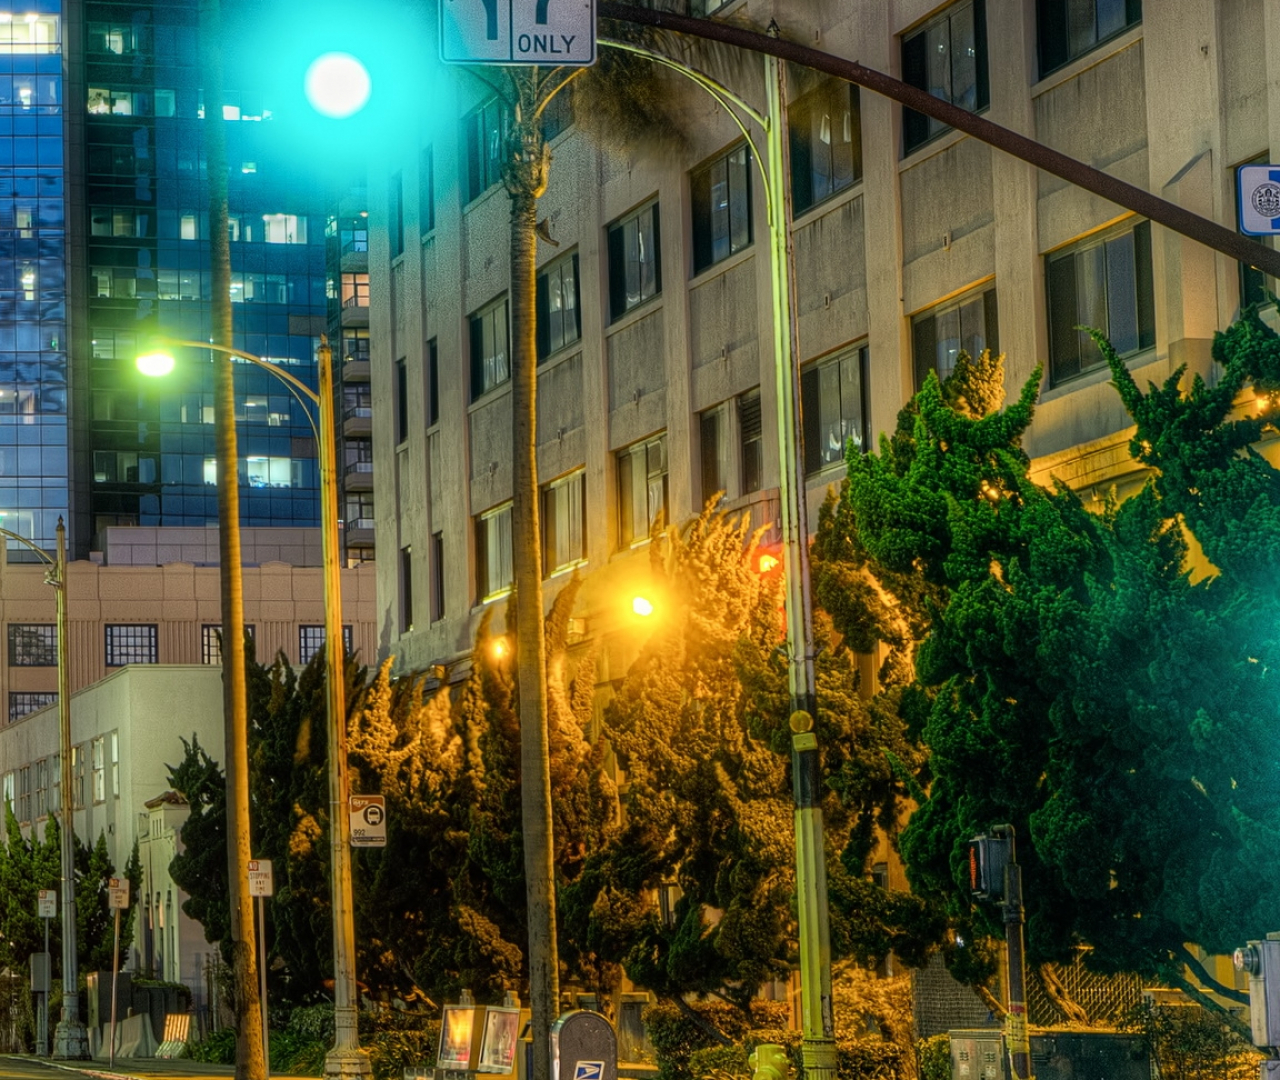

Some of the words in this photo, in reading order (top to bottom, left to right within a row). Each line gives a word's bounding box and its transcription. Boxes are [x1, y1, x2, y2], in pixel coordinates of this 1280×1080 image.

[518, 34, 576, 54] ONLY
[249, 861, 258, 871] NO
[250, 872, 270, 880] STOPPING
